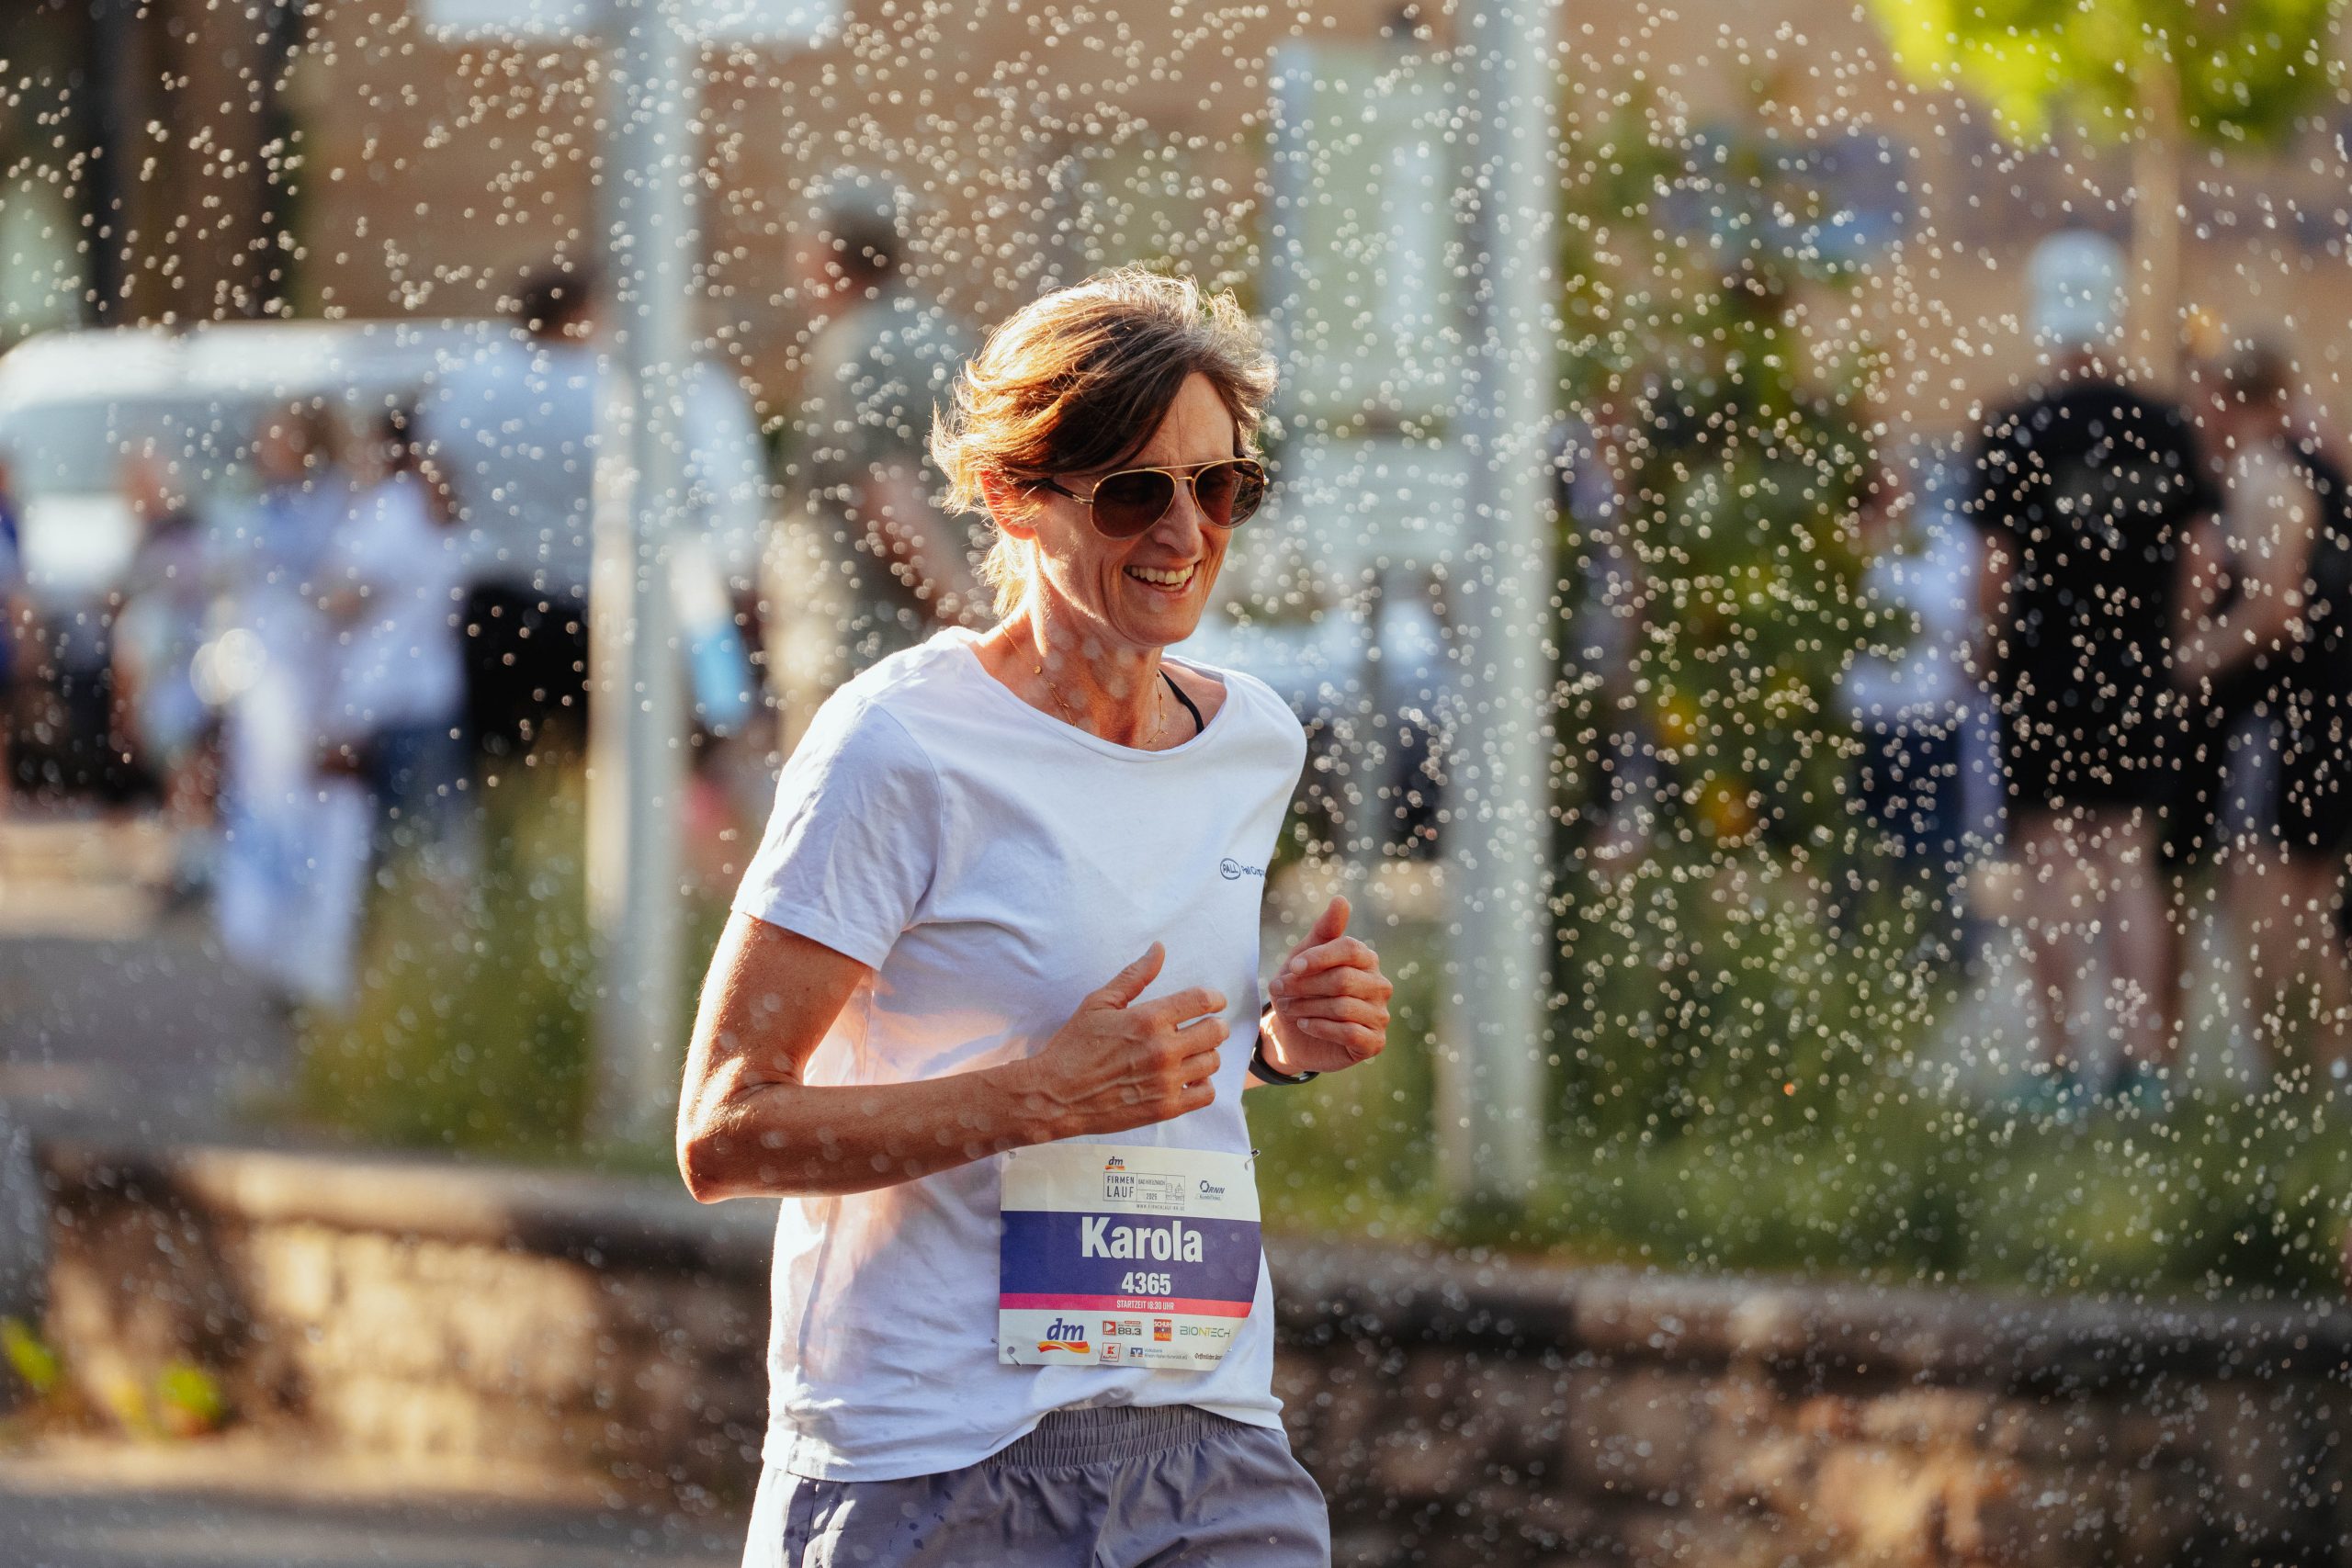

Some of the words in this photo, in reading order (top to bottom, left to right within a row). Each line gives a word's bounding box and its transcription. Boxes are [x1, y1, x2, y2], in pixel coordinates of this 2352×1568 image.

[1223, 863, 1238, 874] PALL
[1108, 1156, 1124, 1166] dm
[1106, 1175, 1135, 1185] FIRMEN
[1106, 1185, 1135, 1198] LAUF
[1081, 1216, 1204, 1263] Karola
[1121, 1272, 1171, 1295] 4365
[1116, 1299, 1147, 1309] STARTZEIT
[1147, 1301, 1162, 1310] 18:30
[1162, 1302, 1175, 1311] UHR
[1046, 1318, 1084, 1341] dm
[1117, 1327, 1142, 1336] 88.3
